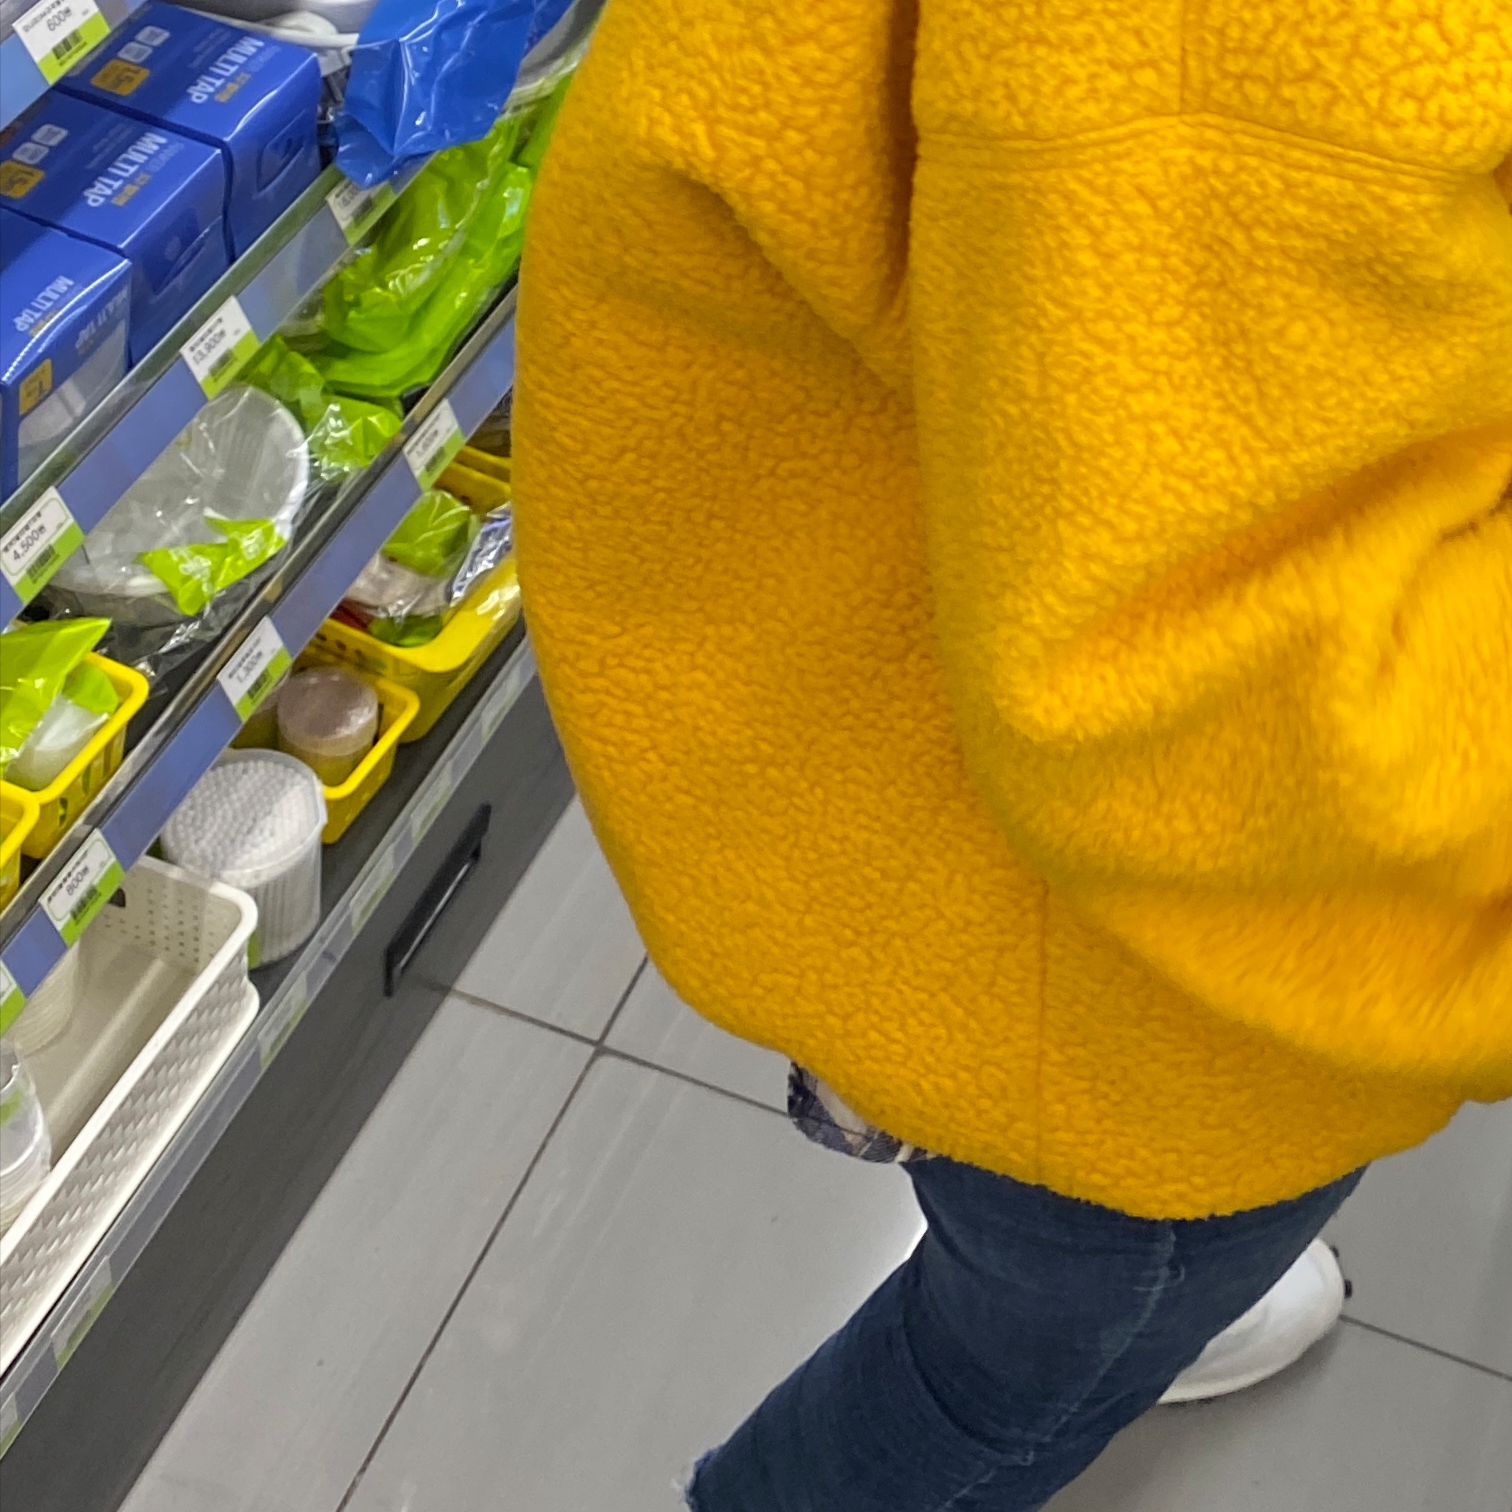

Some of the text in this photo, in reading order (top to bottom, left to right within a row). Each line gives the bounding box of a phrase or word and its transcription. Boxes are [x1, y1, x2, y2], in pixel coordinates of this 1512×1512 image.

[187, 36, 265, 104] MULTI TAP
[84, 132, 168, 208] MULTI TAP
[13, 274, 75, 333] MULTI TAP
